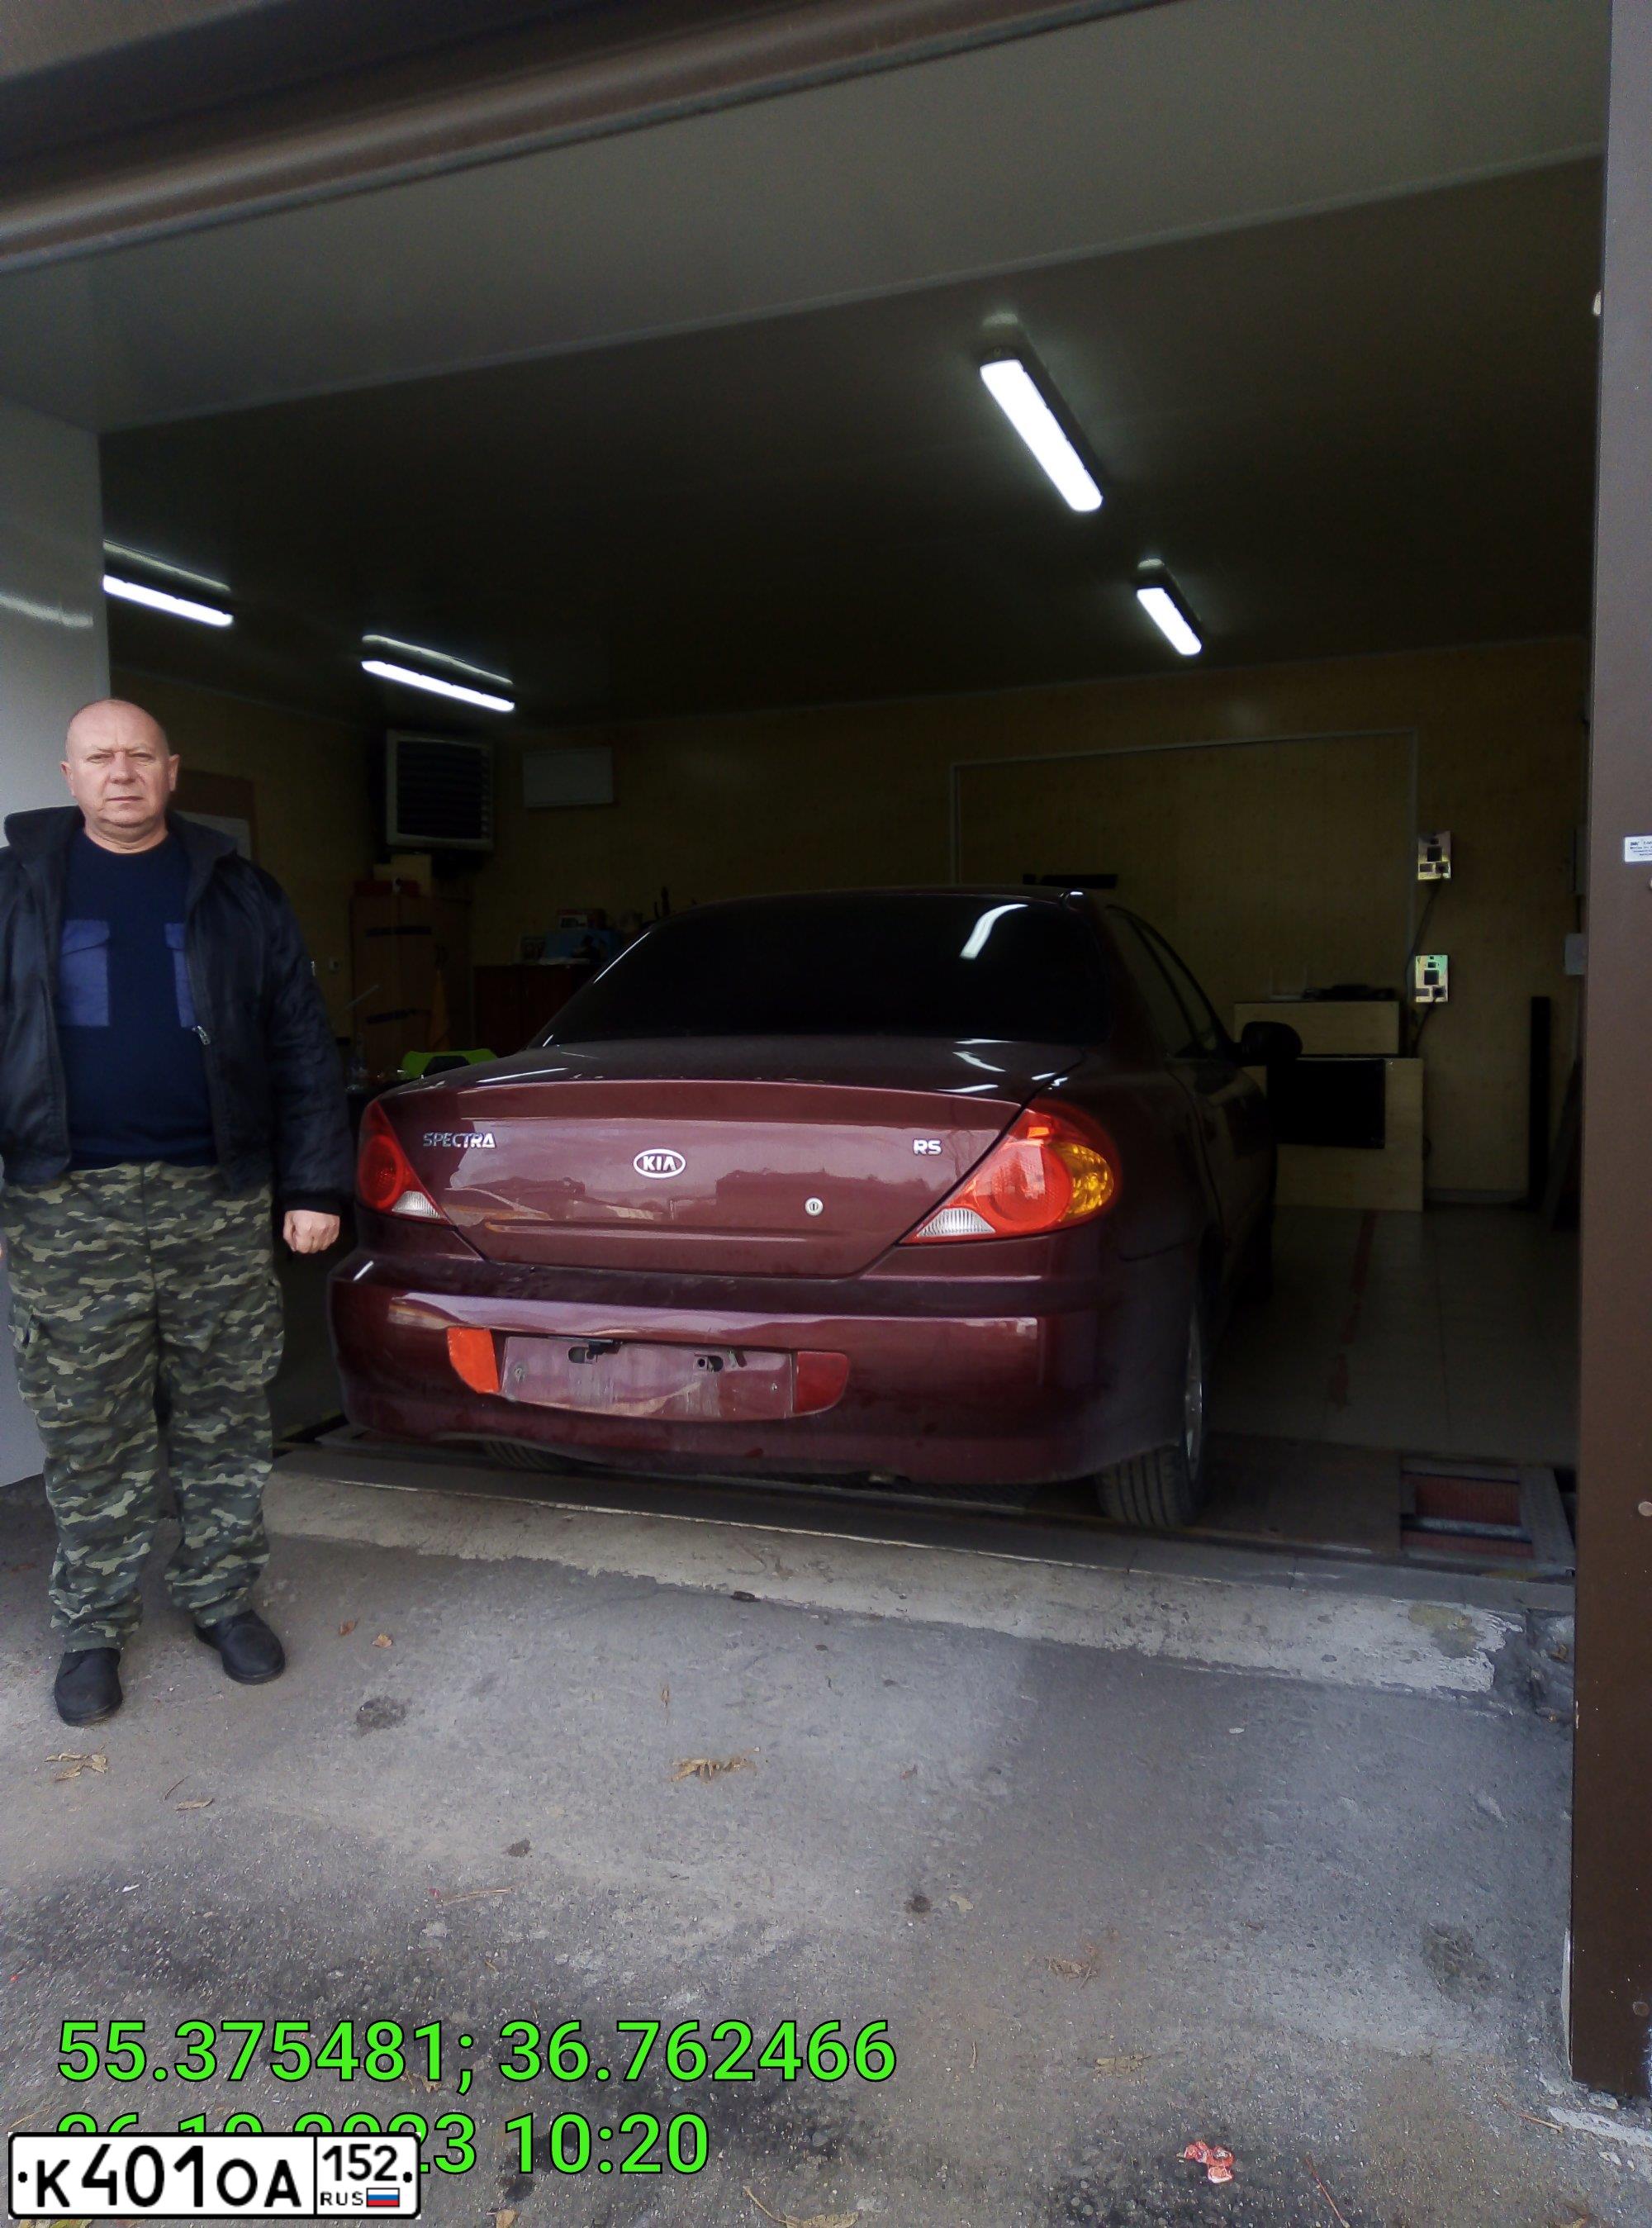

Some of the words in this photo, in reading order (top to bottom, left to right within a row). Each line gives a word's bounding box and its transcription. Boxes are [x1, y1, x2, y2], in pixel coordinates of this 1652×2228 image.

[423, 1133, 496, 1148] SPECTRA
[913, 1139, 942, 1156] RS
[643, 1156, 676, 1171] KIA
